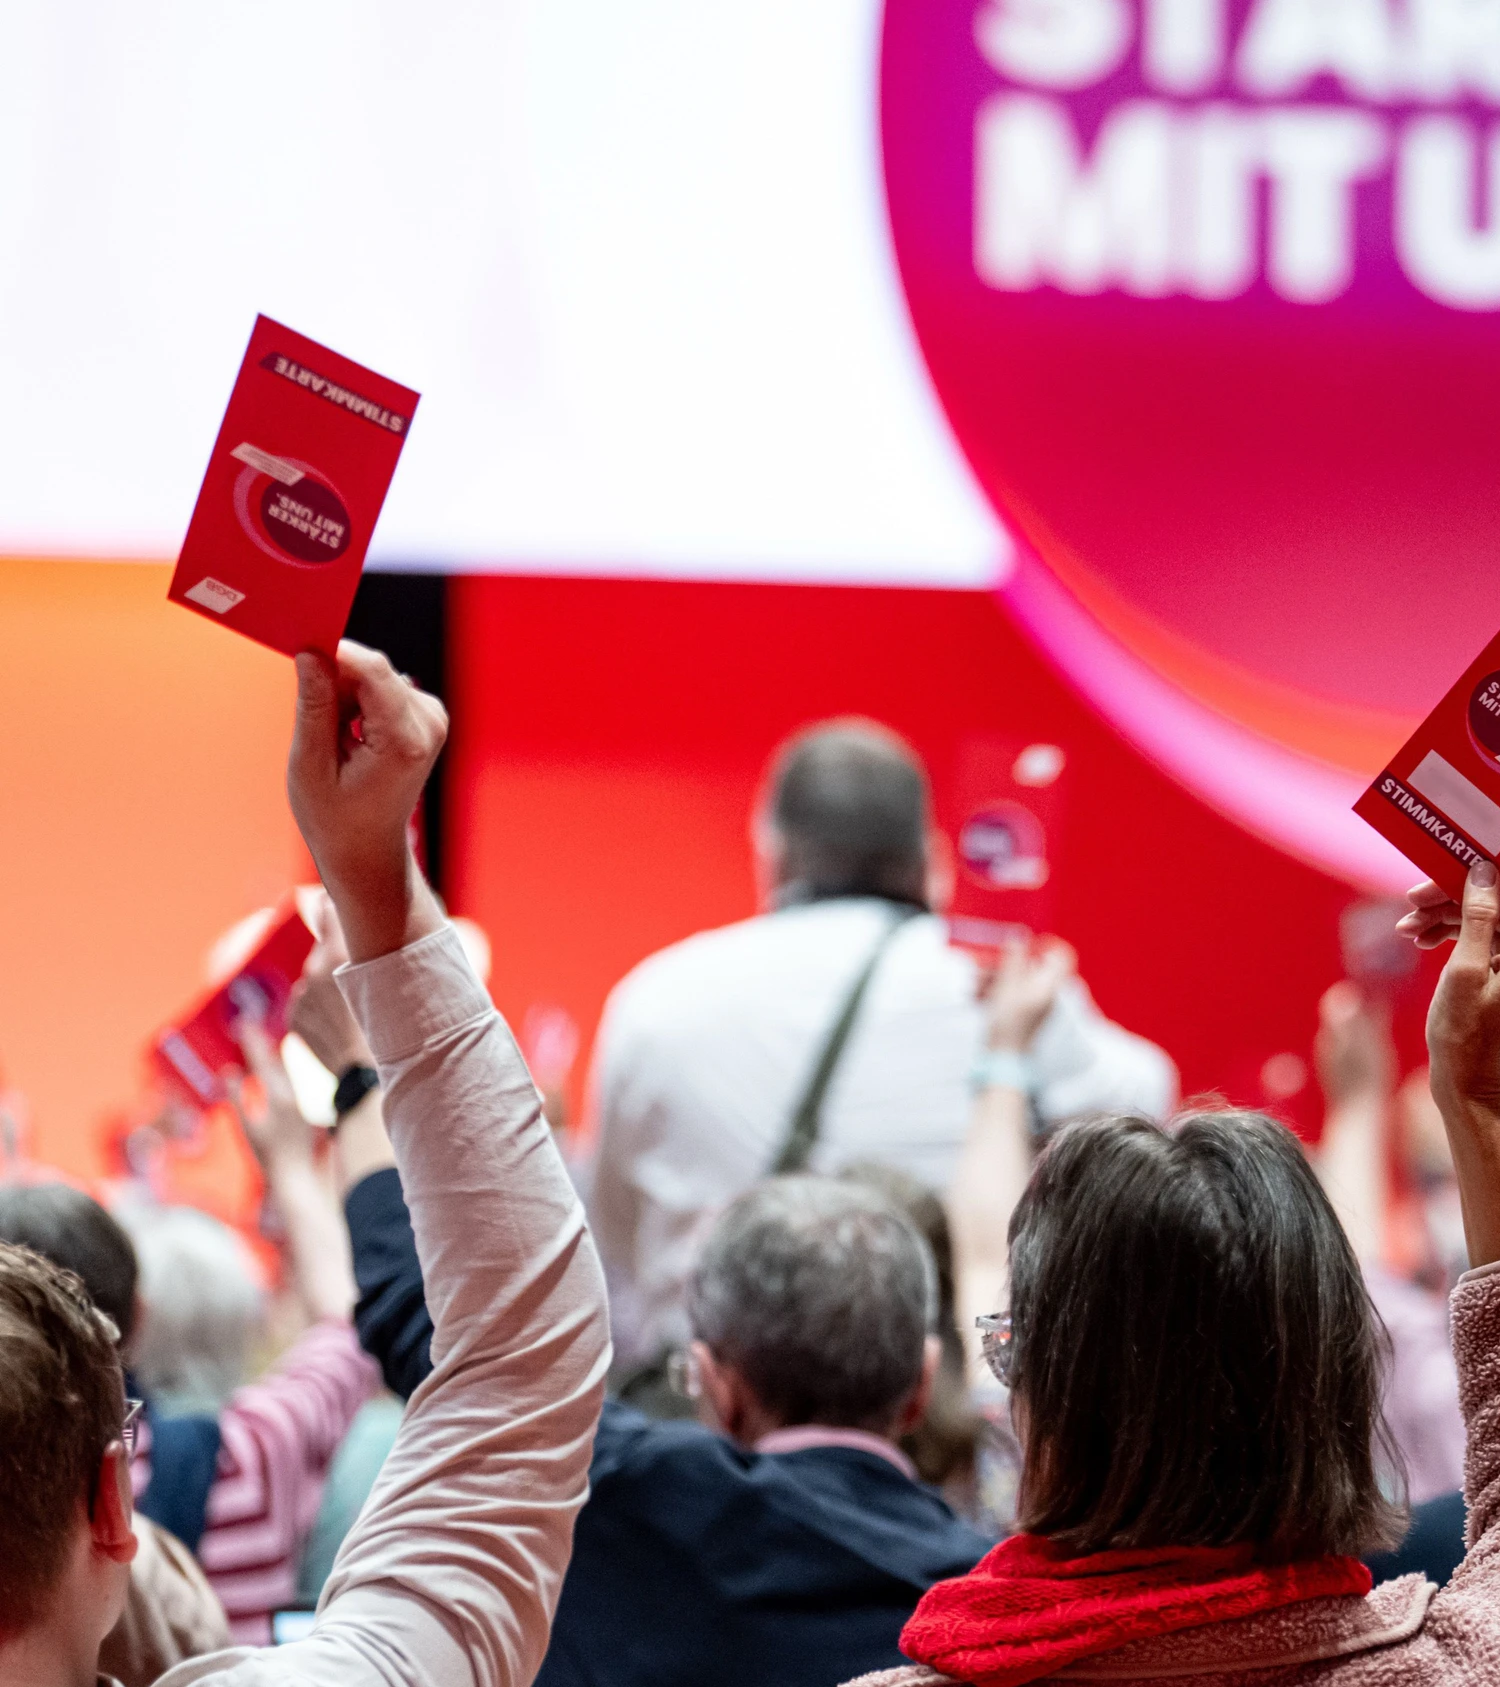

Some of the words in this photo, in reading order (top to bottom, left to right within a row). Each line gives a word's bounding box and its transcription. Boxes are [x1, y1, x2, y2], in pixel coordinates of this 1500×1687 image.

[974, 90, 1387, 302] MIT
[274, 356, 404, 433] STIMMKARTE
[268, 503, 340, 549] STÄRKER
[276, 492, 314, 521] UNS.
[313, 514, 345, 538] MIT
